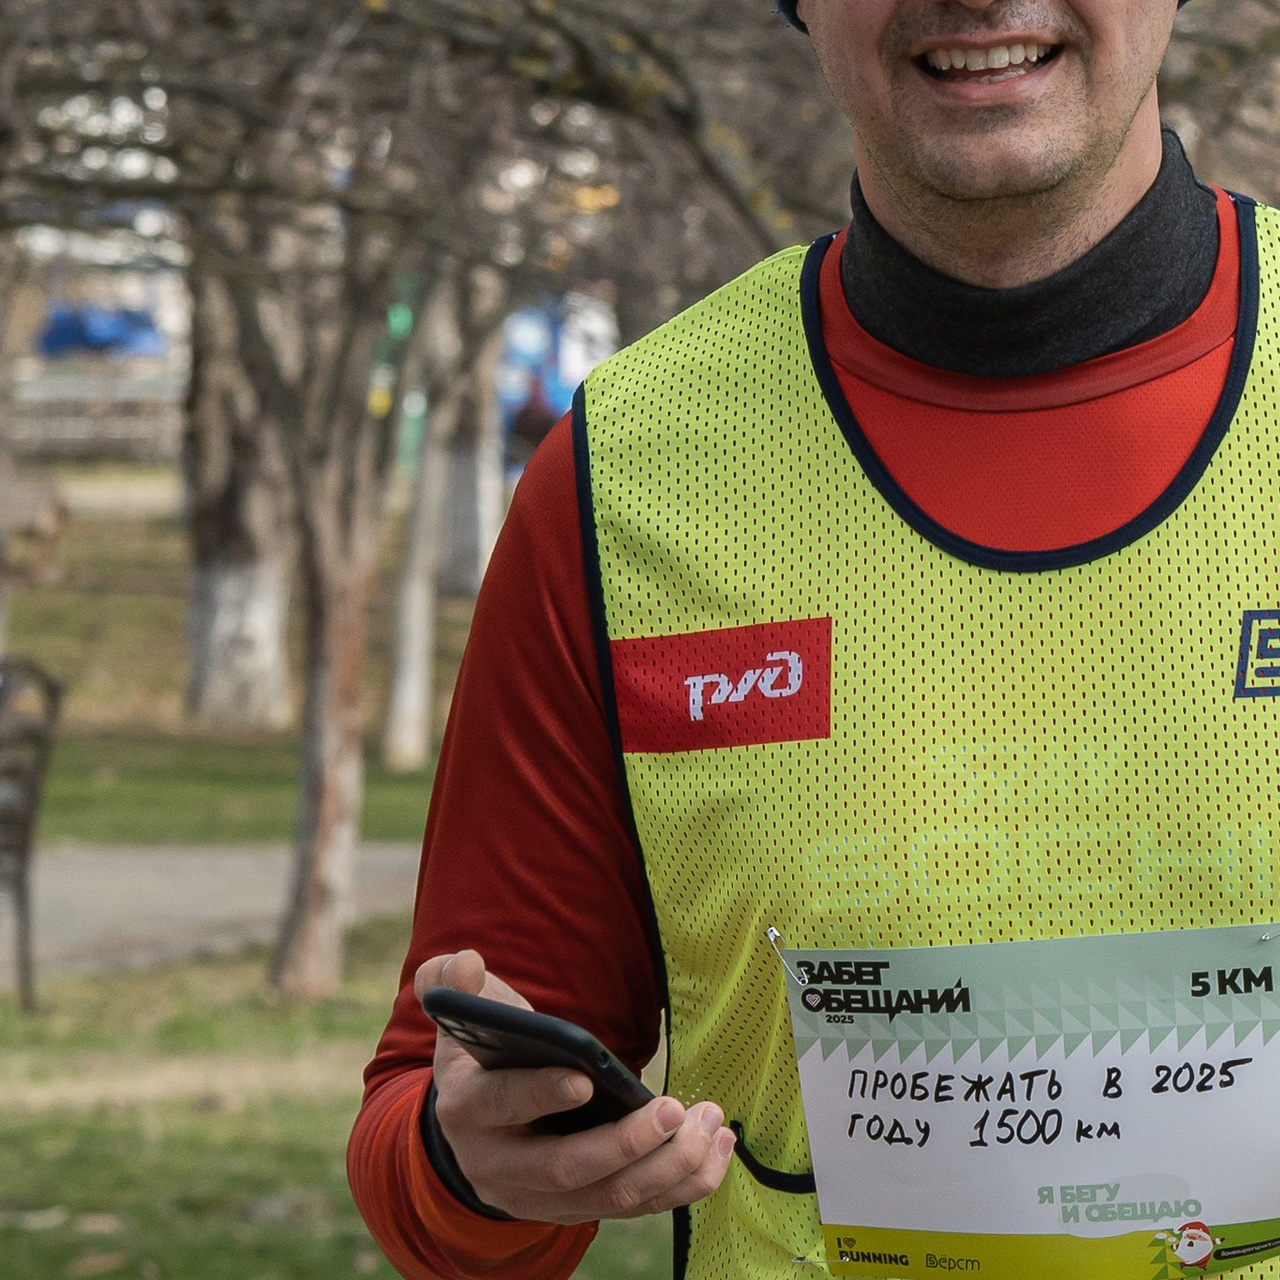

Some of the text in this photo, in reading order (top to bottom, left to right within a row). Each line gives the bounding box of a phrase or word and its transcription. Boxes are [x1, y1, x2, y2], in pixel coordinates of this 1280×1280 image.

[795, 960, 890, 986] ЗАБЕГ
[1190, 971, 1211, 998] 5
[801, 976, 971, 1023] ОБЕЩАНИЙ
[825, 1014, 855, 1025] 2025
[848, 1069, 1062, 1103] ПРОБЕЖАТЬ
[1151, 1057, 1253, 1094] 2025
[969, 1108, 1063, 1147] 1500
[1037, 1183, 1121, 1205] Я БЕГУ
[1061, 1198, 1203, 1224] И ОБЕЩАЮ
[838, 1249, 910, 1267] RUNNING
